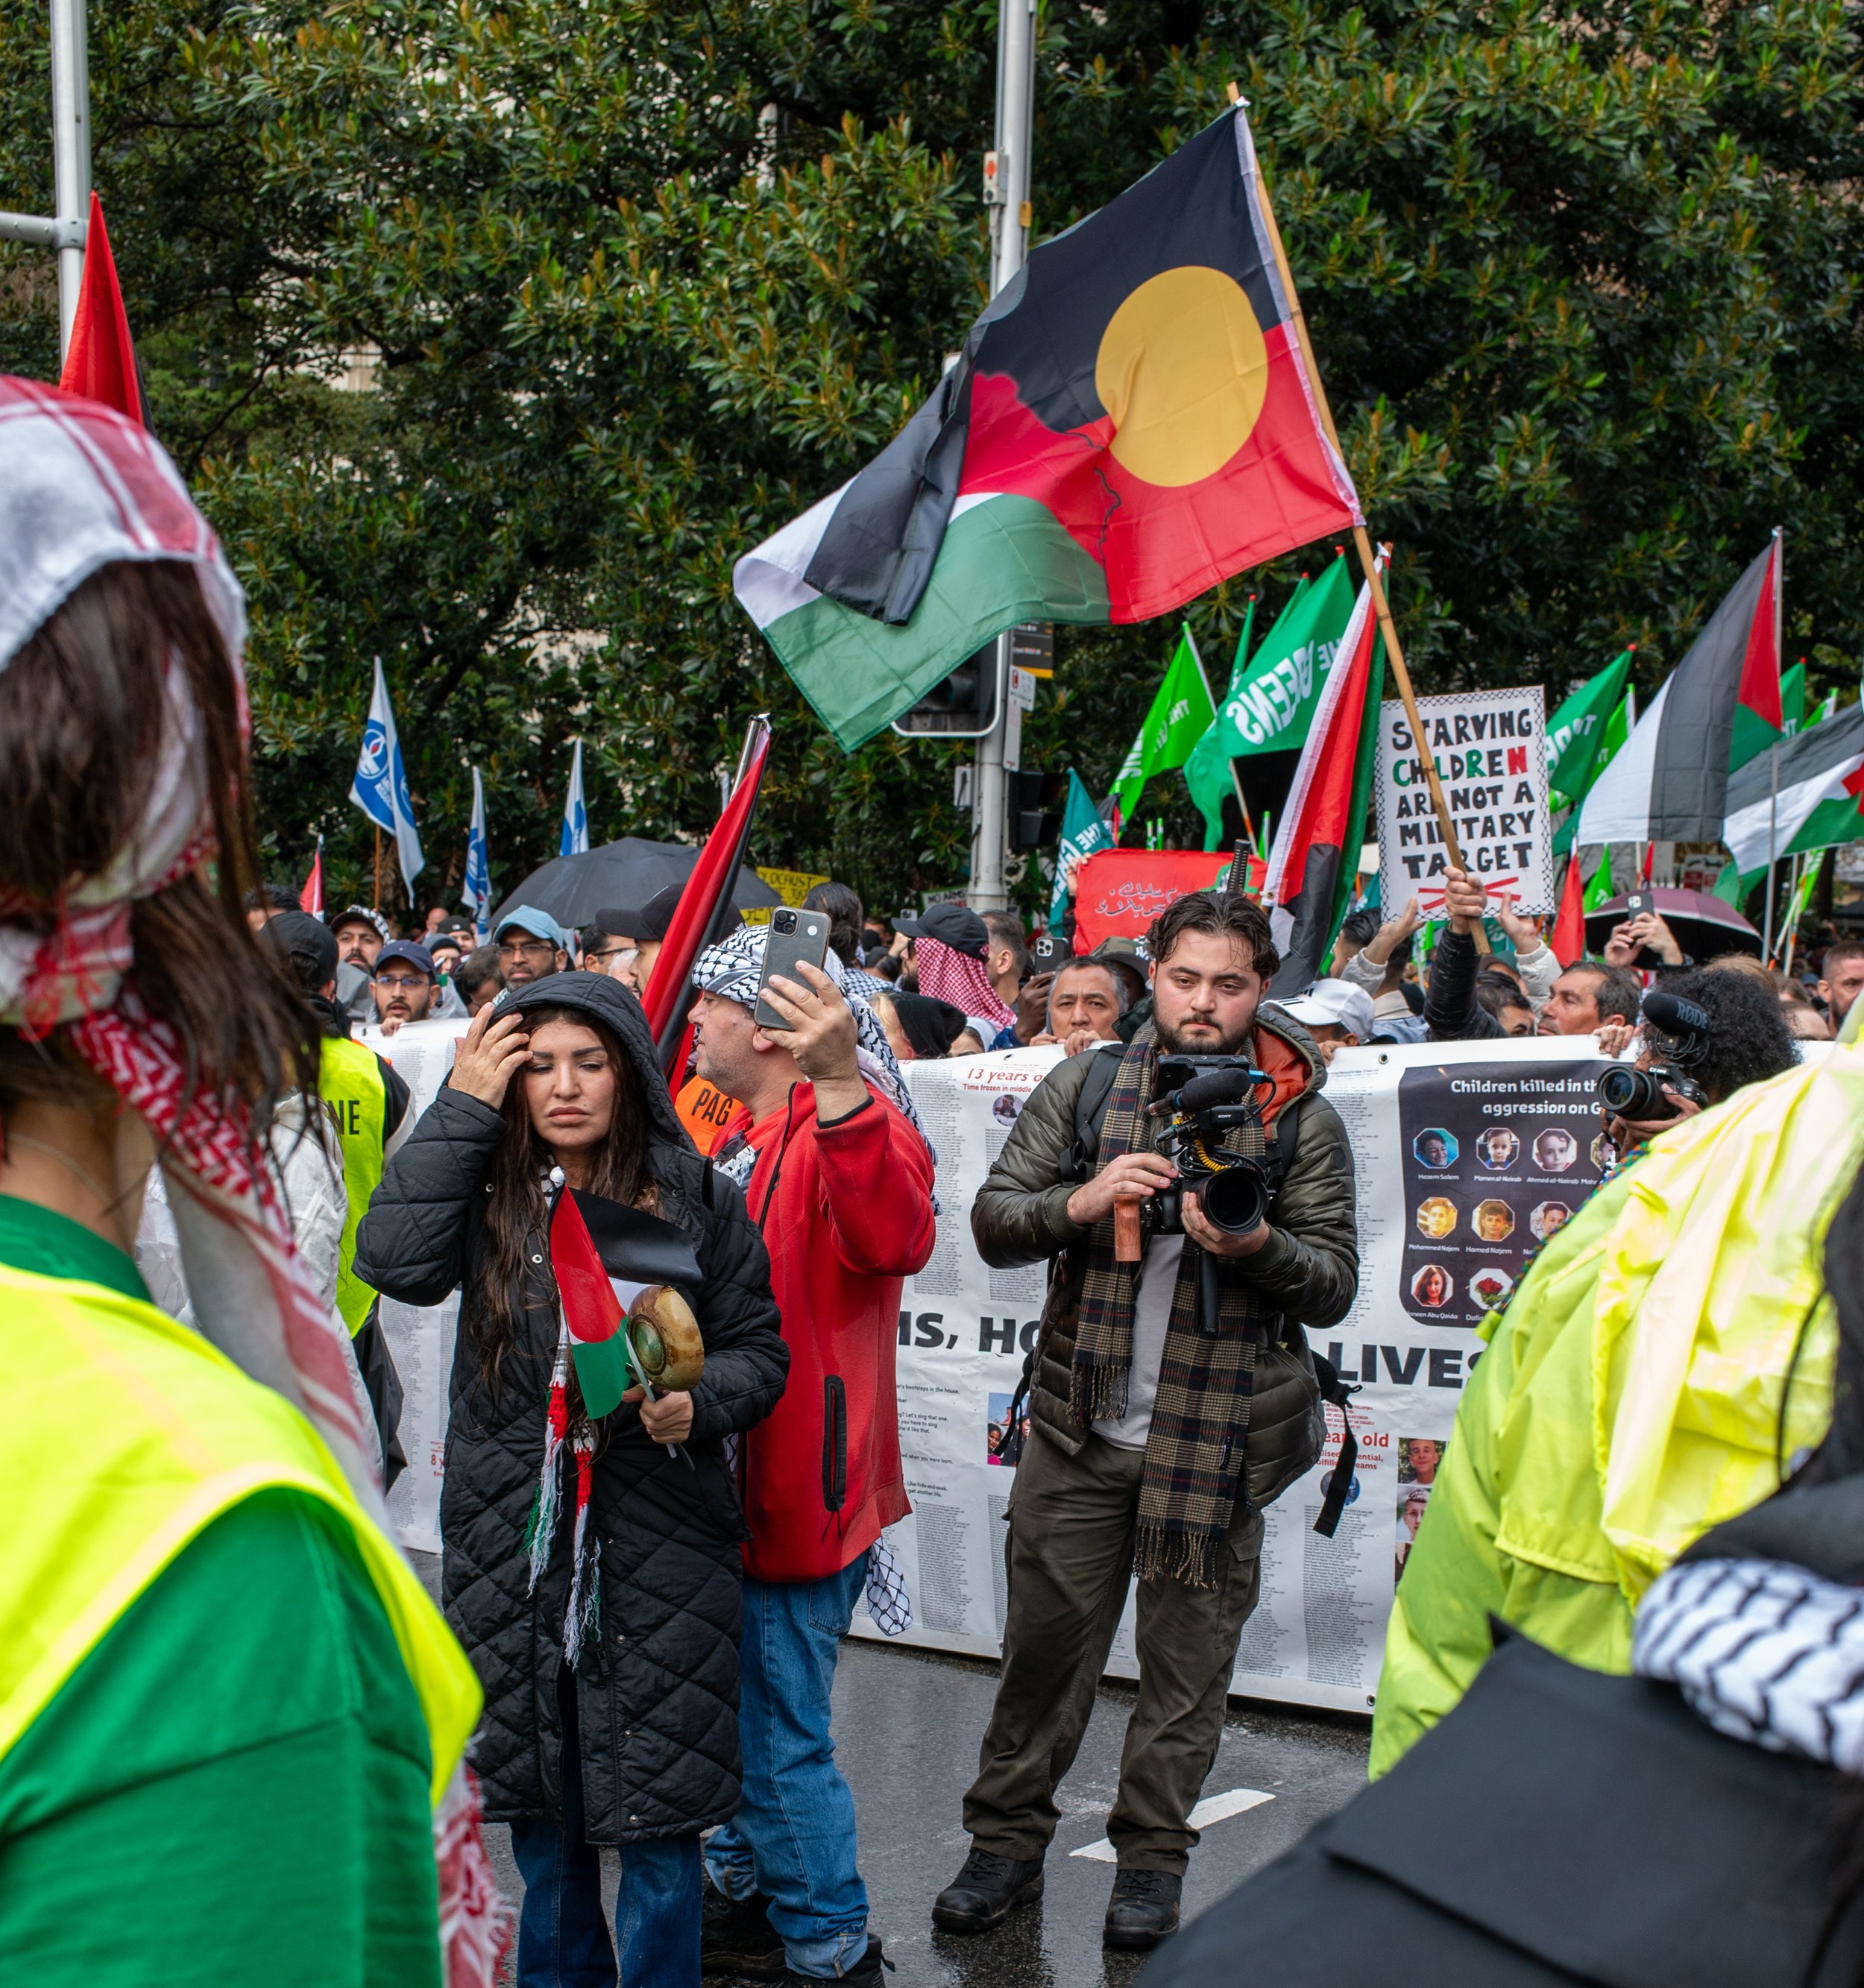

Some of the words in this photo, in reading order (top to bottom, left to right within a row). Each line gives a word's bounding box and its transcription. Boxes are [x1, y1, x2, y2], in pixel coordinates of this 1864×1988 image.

[1393, 745, 1528, 786] CHLDREN
[1450, 784, 1504, 812] NOT
[1514, 781, 1535, 804] A
[1402, 842, 1533, 879] TARGET
[1676, 1000, 1709, 1029] RØDE
[968, 1068, 985, 1080] 13
[987, 1071, 1030, 1084] years
[963, 1083, 979, 1091] Time
[980, 1084, 1001, 1092] frozen
[1002, 1085, 1008, 1093] in
[1010, 1085, 1033, 1094] middle
[1450, 1079, 1517, 1094] Children
[1520, 1078, 1565, 1094] killed
[1567, 1079, 1581, 1093] in
[1584, 1079, 1598, 1094] th
[1482, 1099, 1569, 1117] aggression
[1571, 1103, 1588, 1116] on
[1590, 1102, 1602, 1116] G
[1465, 1246, 1490, 1255] Hamed
[1362, 1432, 1389, 1448] old
[431, 1454, 436, 1465] 8
[1357, 1453, 1384, 1462] ential,
